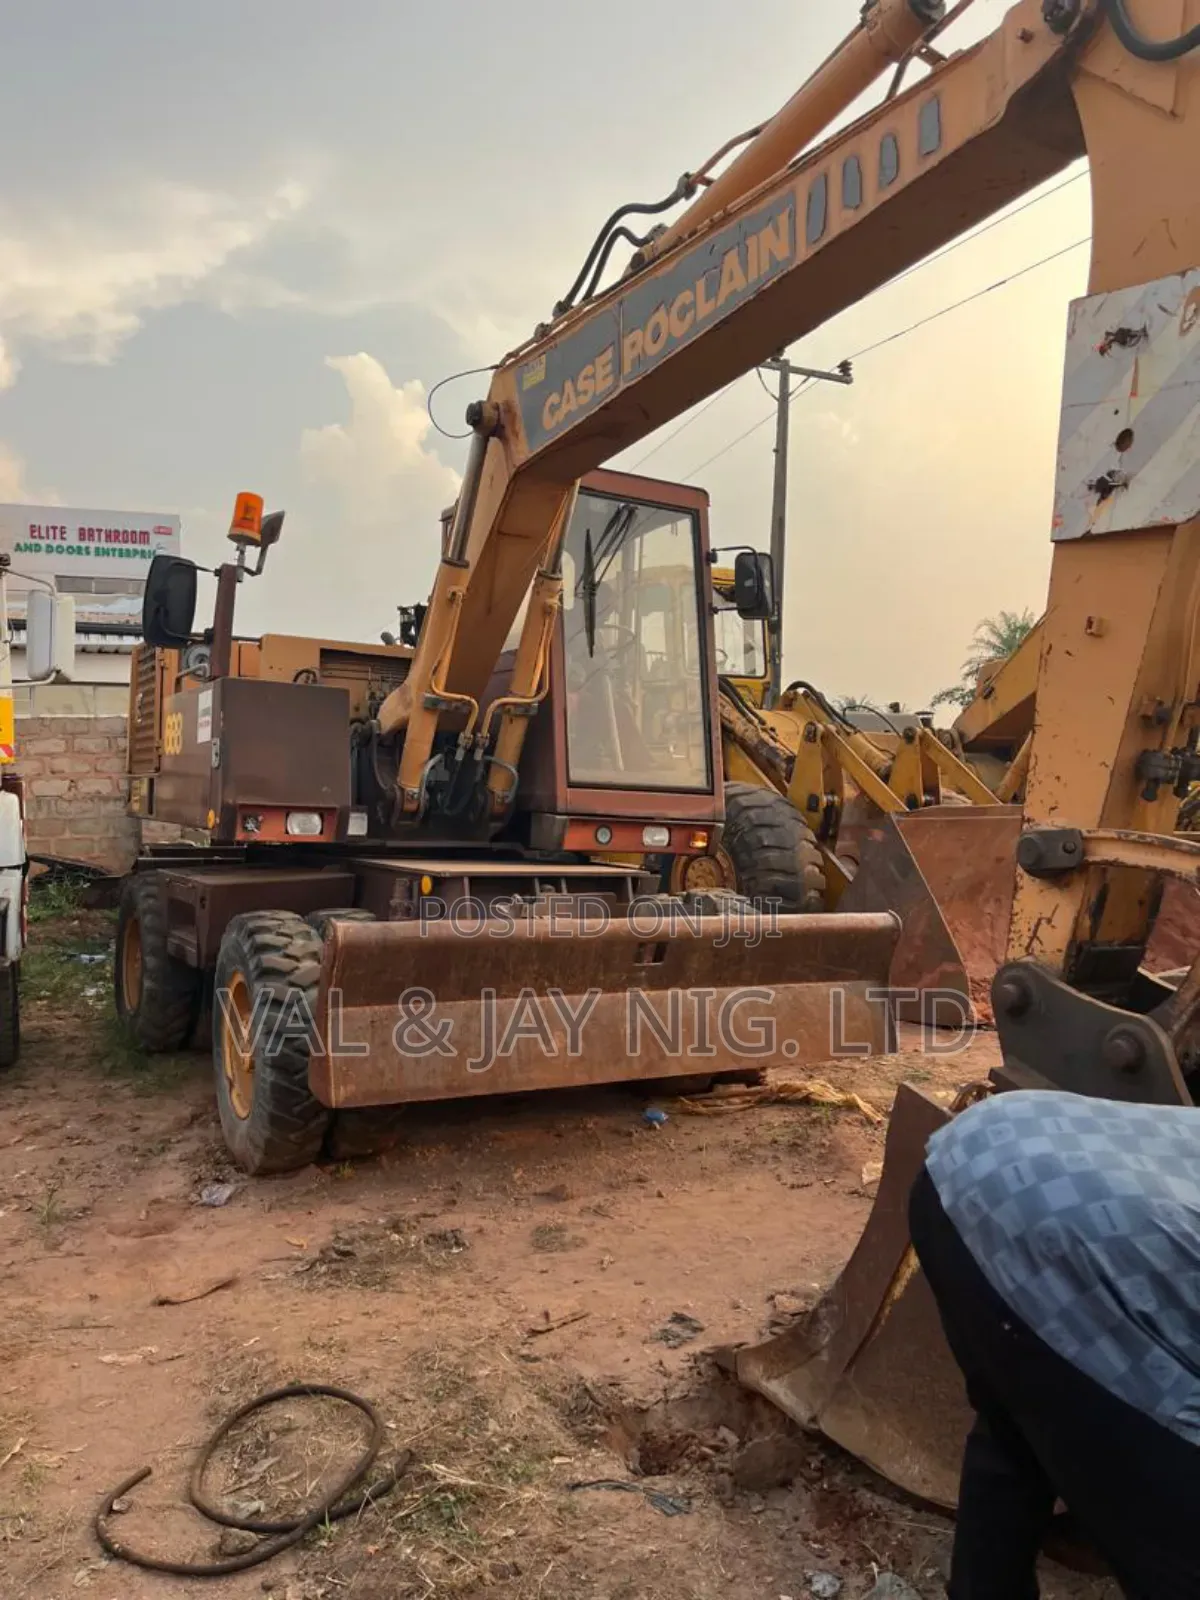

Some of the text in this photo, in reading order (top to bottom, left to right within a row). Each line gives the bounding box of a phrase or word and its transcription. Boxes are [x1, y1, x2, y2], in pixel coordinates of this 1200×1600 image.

[541, 207, 792, 431] CASE POCLAIN
[29, 523, 68, 542] ELITE
[78, 526, 151, 546] BATHROOM
[14, 542, 42, 554] AND
[44, 544, 91, 557] DOORS
